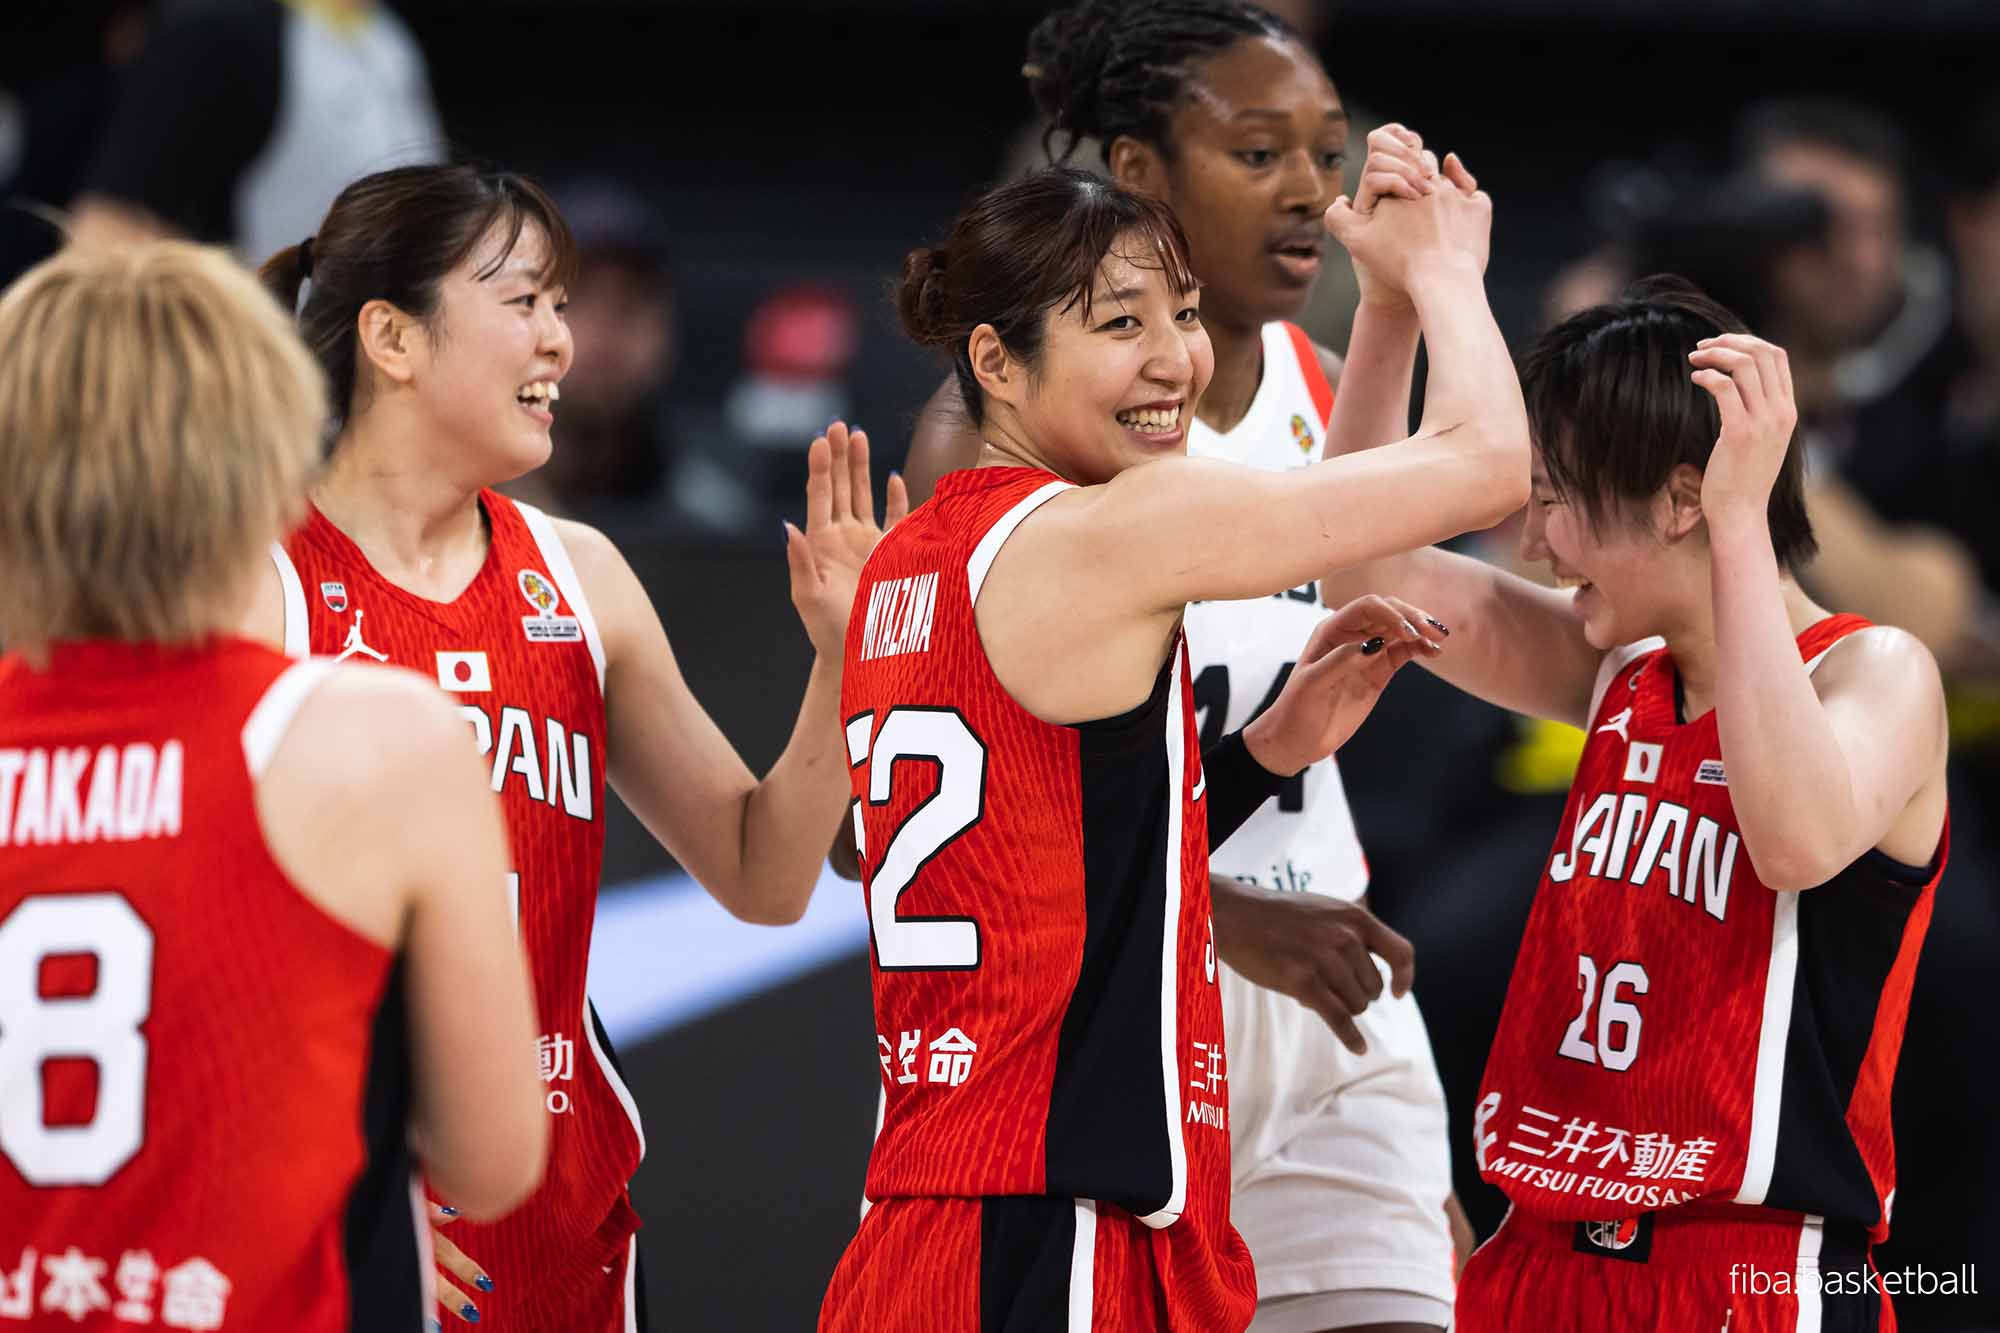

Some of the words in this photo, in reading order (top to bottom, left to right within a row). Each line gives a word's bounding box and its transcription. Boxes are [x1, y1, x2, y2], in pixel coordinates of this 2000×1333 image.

[860, 571, 939, 662] MIYAZAWA
[0, 738, 184, 847] TAKADA
[1549, 792, 1741, 924] JAPAN
[0, 889, 155, 1188] 8
[1556, 952, 1650, 1073] 26
[1190, 1041, 1230, 1095] 三井
[1488, 1156, 1578, 1193] MITSUI
[1508, 1104, 1718, 1182] 三井不動産
